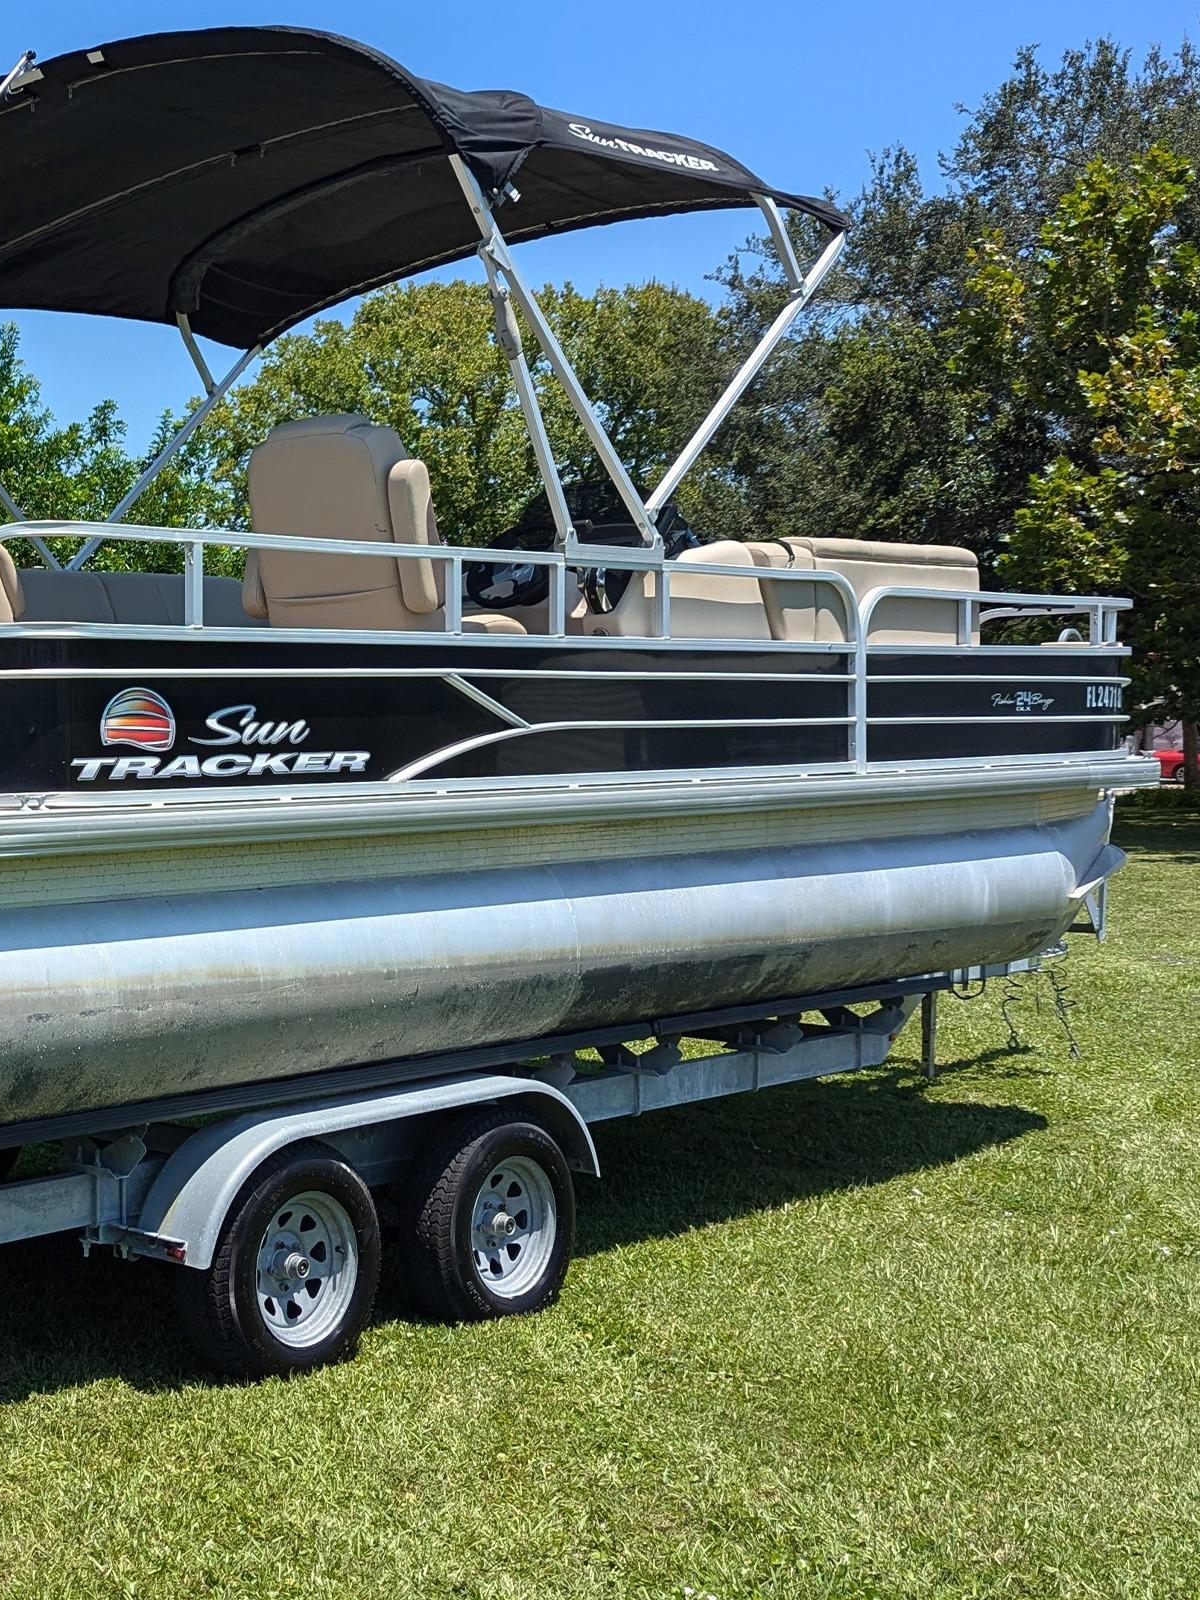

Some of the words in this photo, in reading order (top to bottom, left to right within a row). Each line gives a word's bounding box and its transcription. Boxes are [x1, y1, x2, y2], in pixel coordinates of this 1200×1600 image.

[567, 123, 618, 149] Sun
[614, 138, 720, 172] TRACKER
[1015, 691, 1032, 706] 24
[187, 704, 311, 746] Sun
[70, 750, 371, 781] TRACKER
